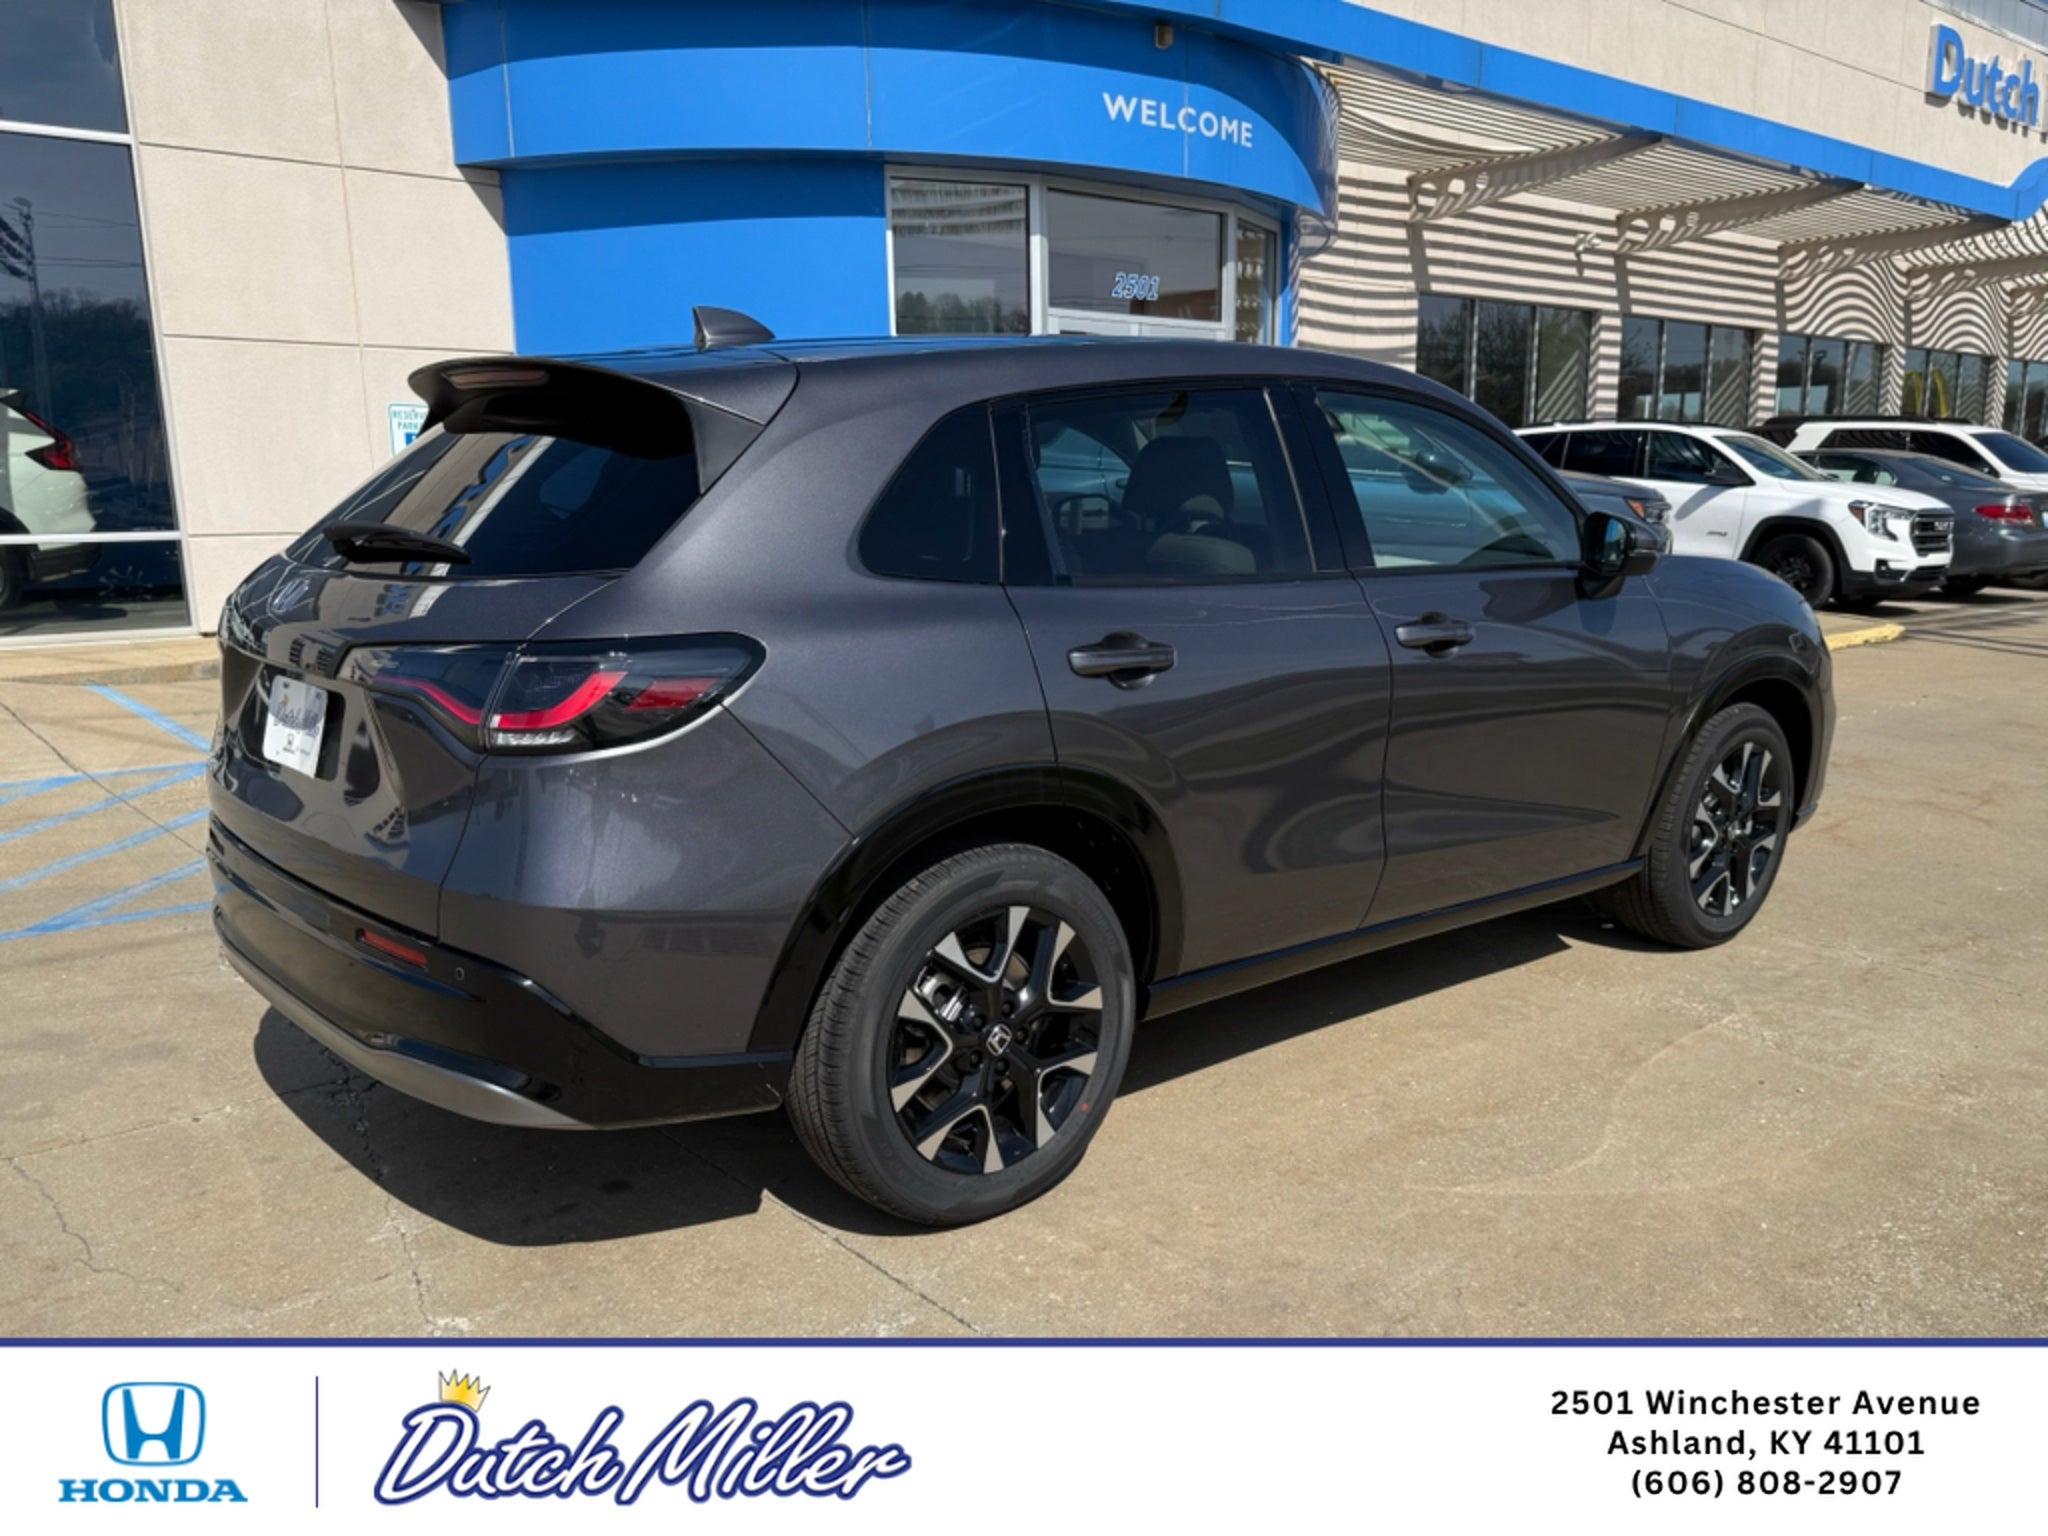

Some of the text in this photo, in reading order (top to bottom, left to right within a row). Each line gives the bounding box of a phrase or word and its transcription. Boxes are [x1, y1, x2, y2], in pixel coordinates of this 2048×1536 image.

[1926, 23, 2039, 126] Dutch
[1102, 92, 1253, 148] WELCOME
[1111, 271, 1160, 301] 2501
[391, 409, 428, 420] RESERV
